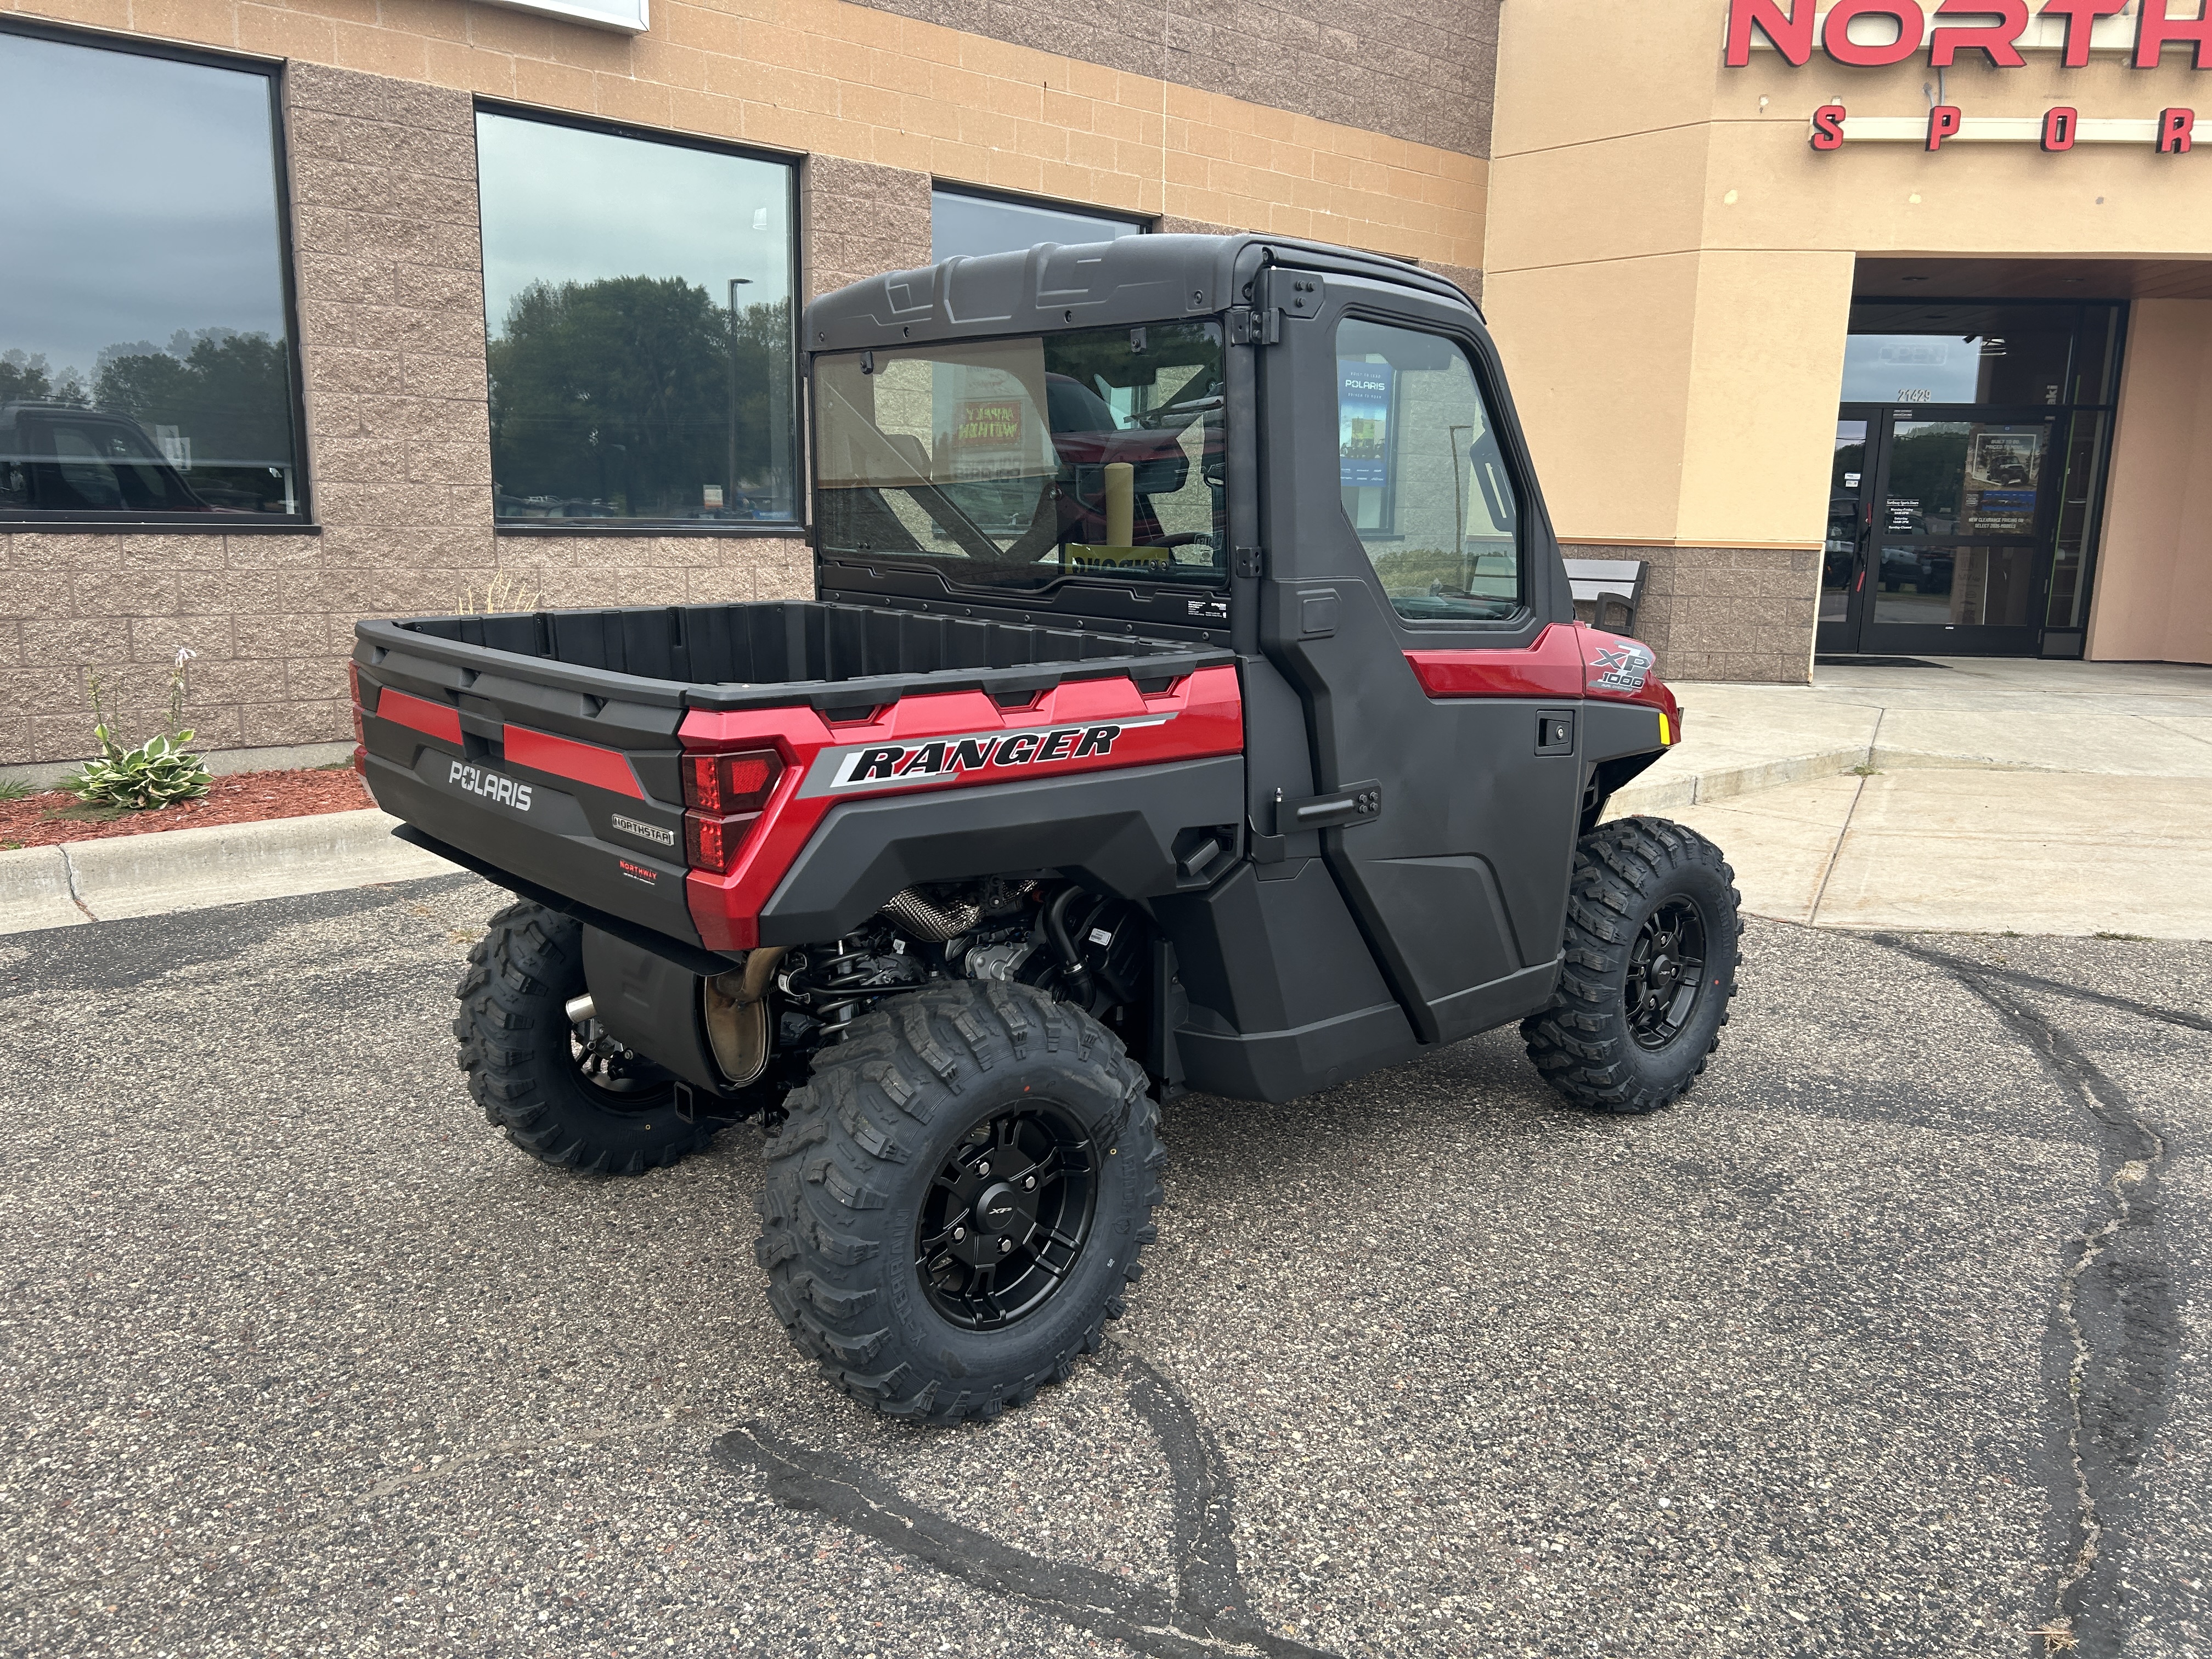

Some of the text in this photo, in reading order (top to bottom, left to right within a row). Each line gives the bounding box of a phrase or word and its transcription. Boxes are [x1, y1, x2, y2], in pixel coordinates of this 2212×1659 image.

[1809, 105, 2195, 154] SPOR
[1345, 379, 1385, 391] POLARIS
[1897, 389, 1931, 402] 21429
[1589, 647, 1651, 673] XP
[1598, 672, 1645, 689] 1000
[847, 724, 1121, 783] RANGER
[449, 760, 532, 811] POLARIS
[614, 817, 668, 842] NORTHSTAR
[619, 860, 657, 880] NORTHWAY
[890, 1209, 928, 1347] X-TERRAIN
